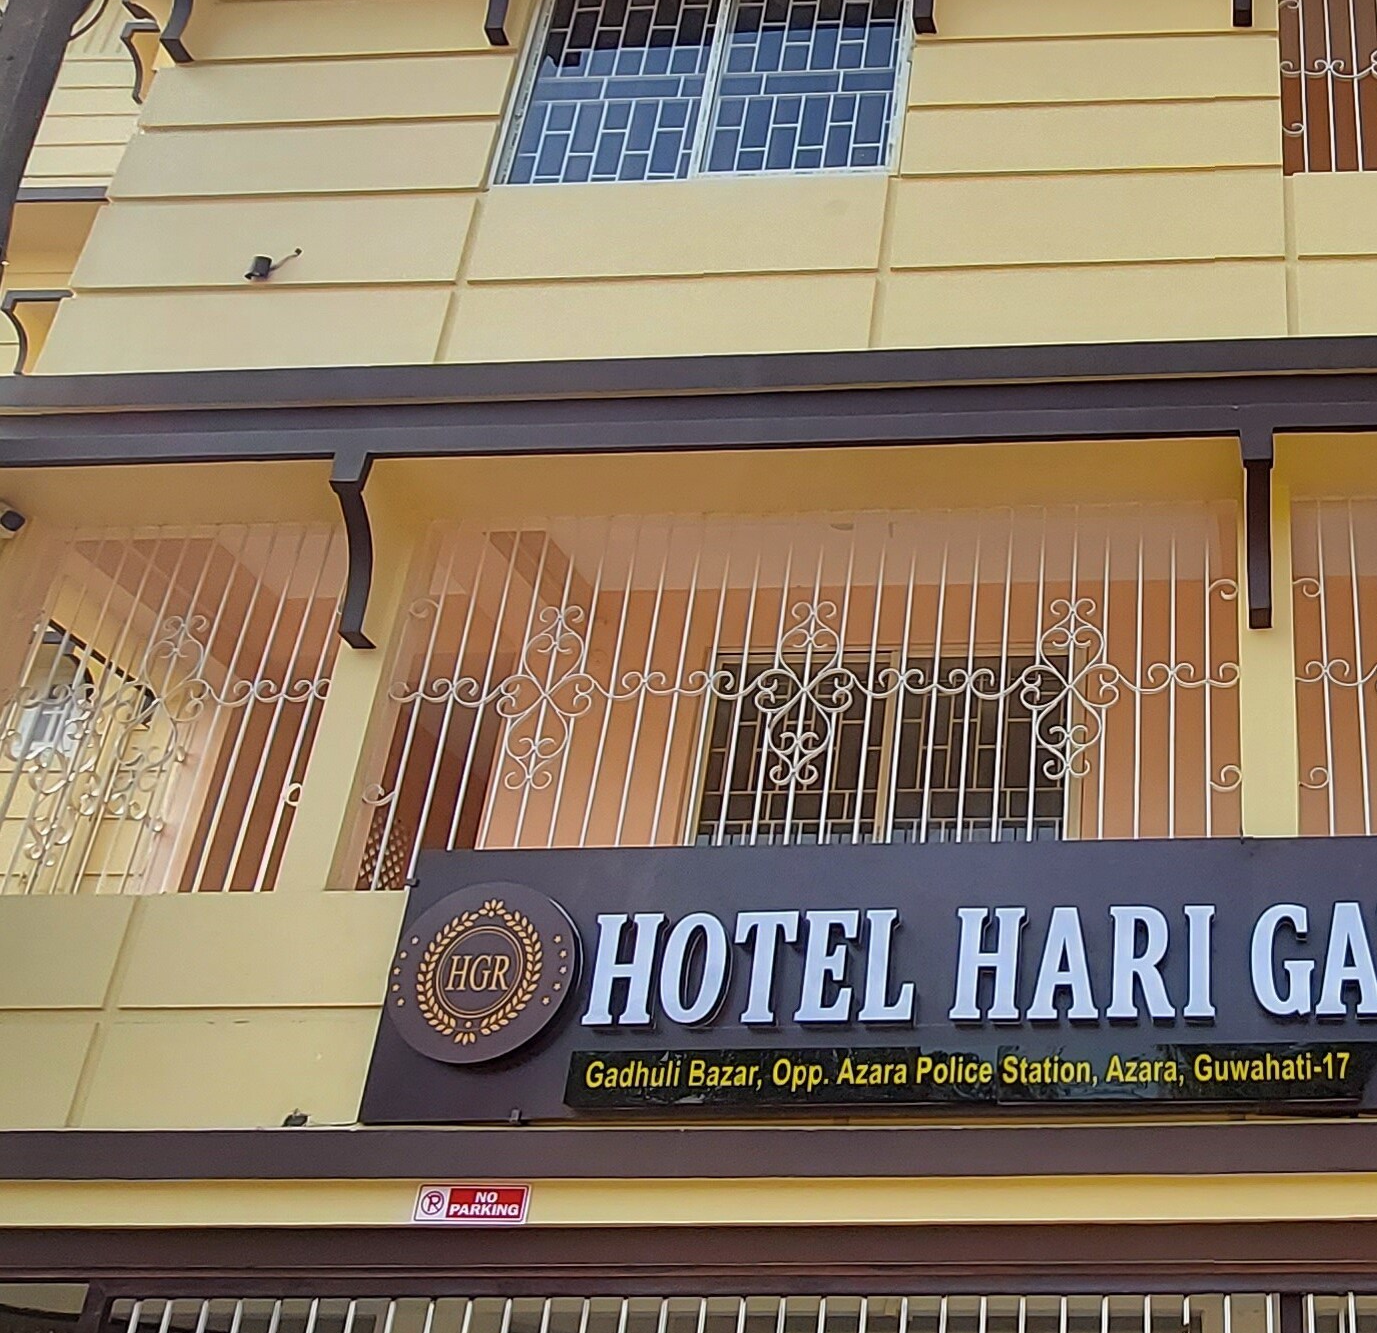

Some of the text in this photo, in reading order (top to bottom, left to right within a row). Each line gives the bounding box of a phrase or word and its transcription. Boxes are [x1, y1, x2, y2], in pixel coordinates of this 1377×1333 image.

[444, 954, 510, 993] HGR
[580, 907, 916, 1026] HOTEL
[948, 904, 1217, 1022] HARI
[584, 1051, 1351, 1093] Gadhuli Bazar, Opp. Azara Police Station, Azara, Guwahati-17
[448, 1203, 520, 1216] PARKING
[474, 1191, 499, 1203] NO
